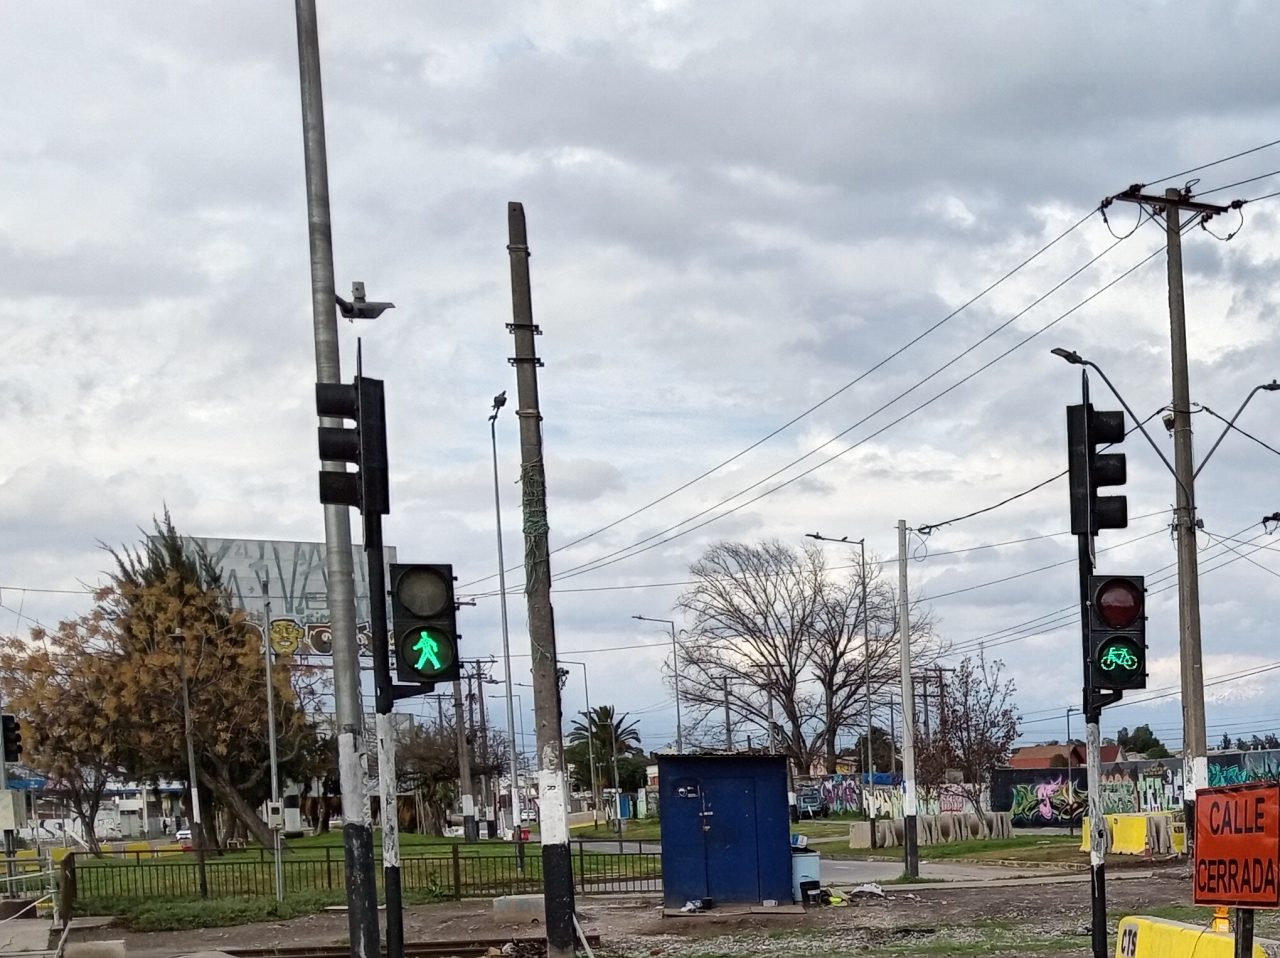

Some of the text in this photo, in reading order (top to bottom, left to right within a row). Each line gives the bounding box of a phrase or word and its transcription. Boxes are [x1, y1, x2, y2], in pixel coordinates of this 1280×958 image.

[1210, 797, 1265, 834] CALLE
[1197, 858, 1276, 894] CERRADA
[1121, 928, 1137, 956] CTS
